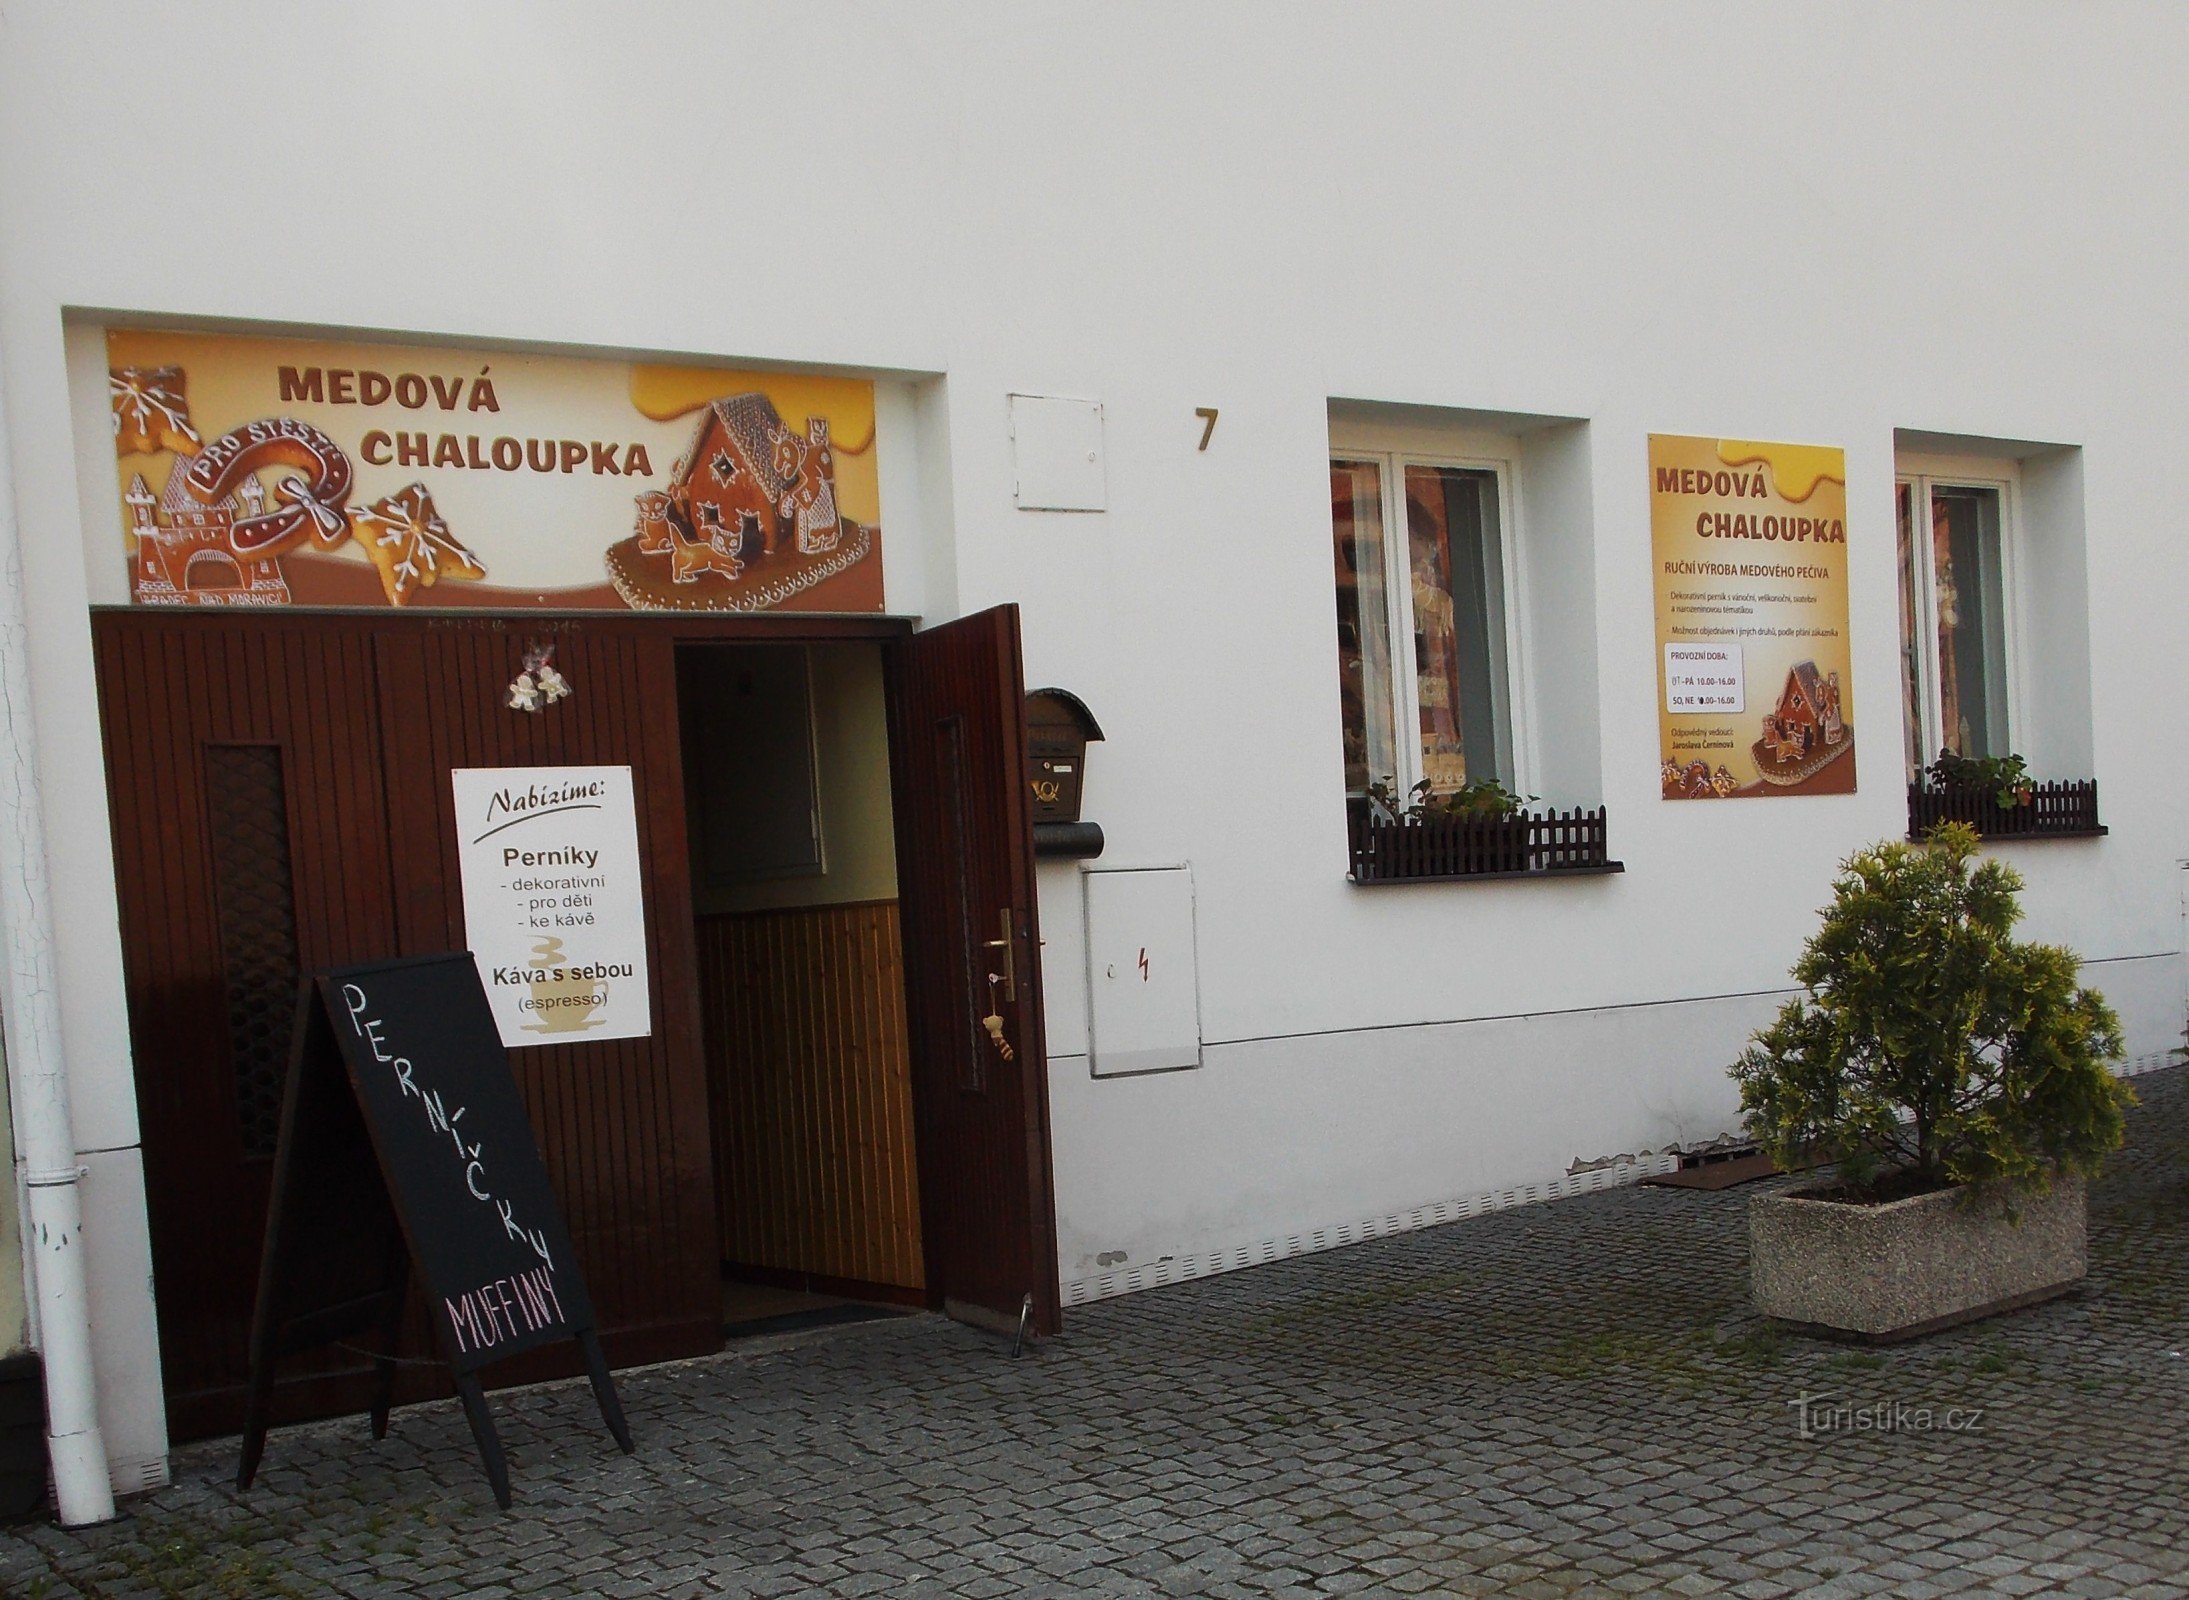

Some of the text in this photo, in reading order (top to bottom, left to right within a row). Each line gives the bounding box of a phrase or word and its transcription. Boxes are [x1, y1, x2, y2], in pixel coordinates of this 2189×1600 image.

[277, 365, 500, 413] MEDOVÁ
[1195, 407, 1219, 451] 7
[193, 434, 241, 480] PRO
[359, 428, 654, 477] CHALOUPKA
[1656, 465, 1768, 498] MEDOVÁ
[1696, 511, 1845, 544] CHALOUPKA
[1664, 561, 1696, 575] RUČNÍ
[1697, 561, 1738, 576] VÝROBA
[1739, 563, 1795, 578] MEDOVÉHO
[1671, 650, 1729, 660] PROVOZNÍ DOBA:
[1672, 696, 1684, 706] SO,
[1685, 696, 1695, 705] NE
[486, 779, 605, 822] Nabízíme:
[503, 846, 599, 869] Perníky
[512, 874, 605, 892] dekorativní
[529, 897, 557, 912] pro
[562, 893, 592, 909] děti
[529, 914, 550, 928] ke
[555, 911, 595, 927] kávě
[493, 961, 633, 986] Káva s sebou
[517, 992, 609, 1014] (espresso)
[445, 1265, 566, 1353] MUFFINY
